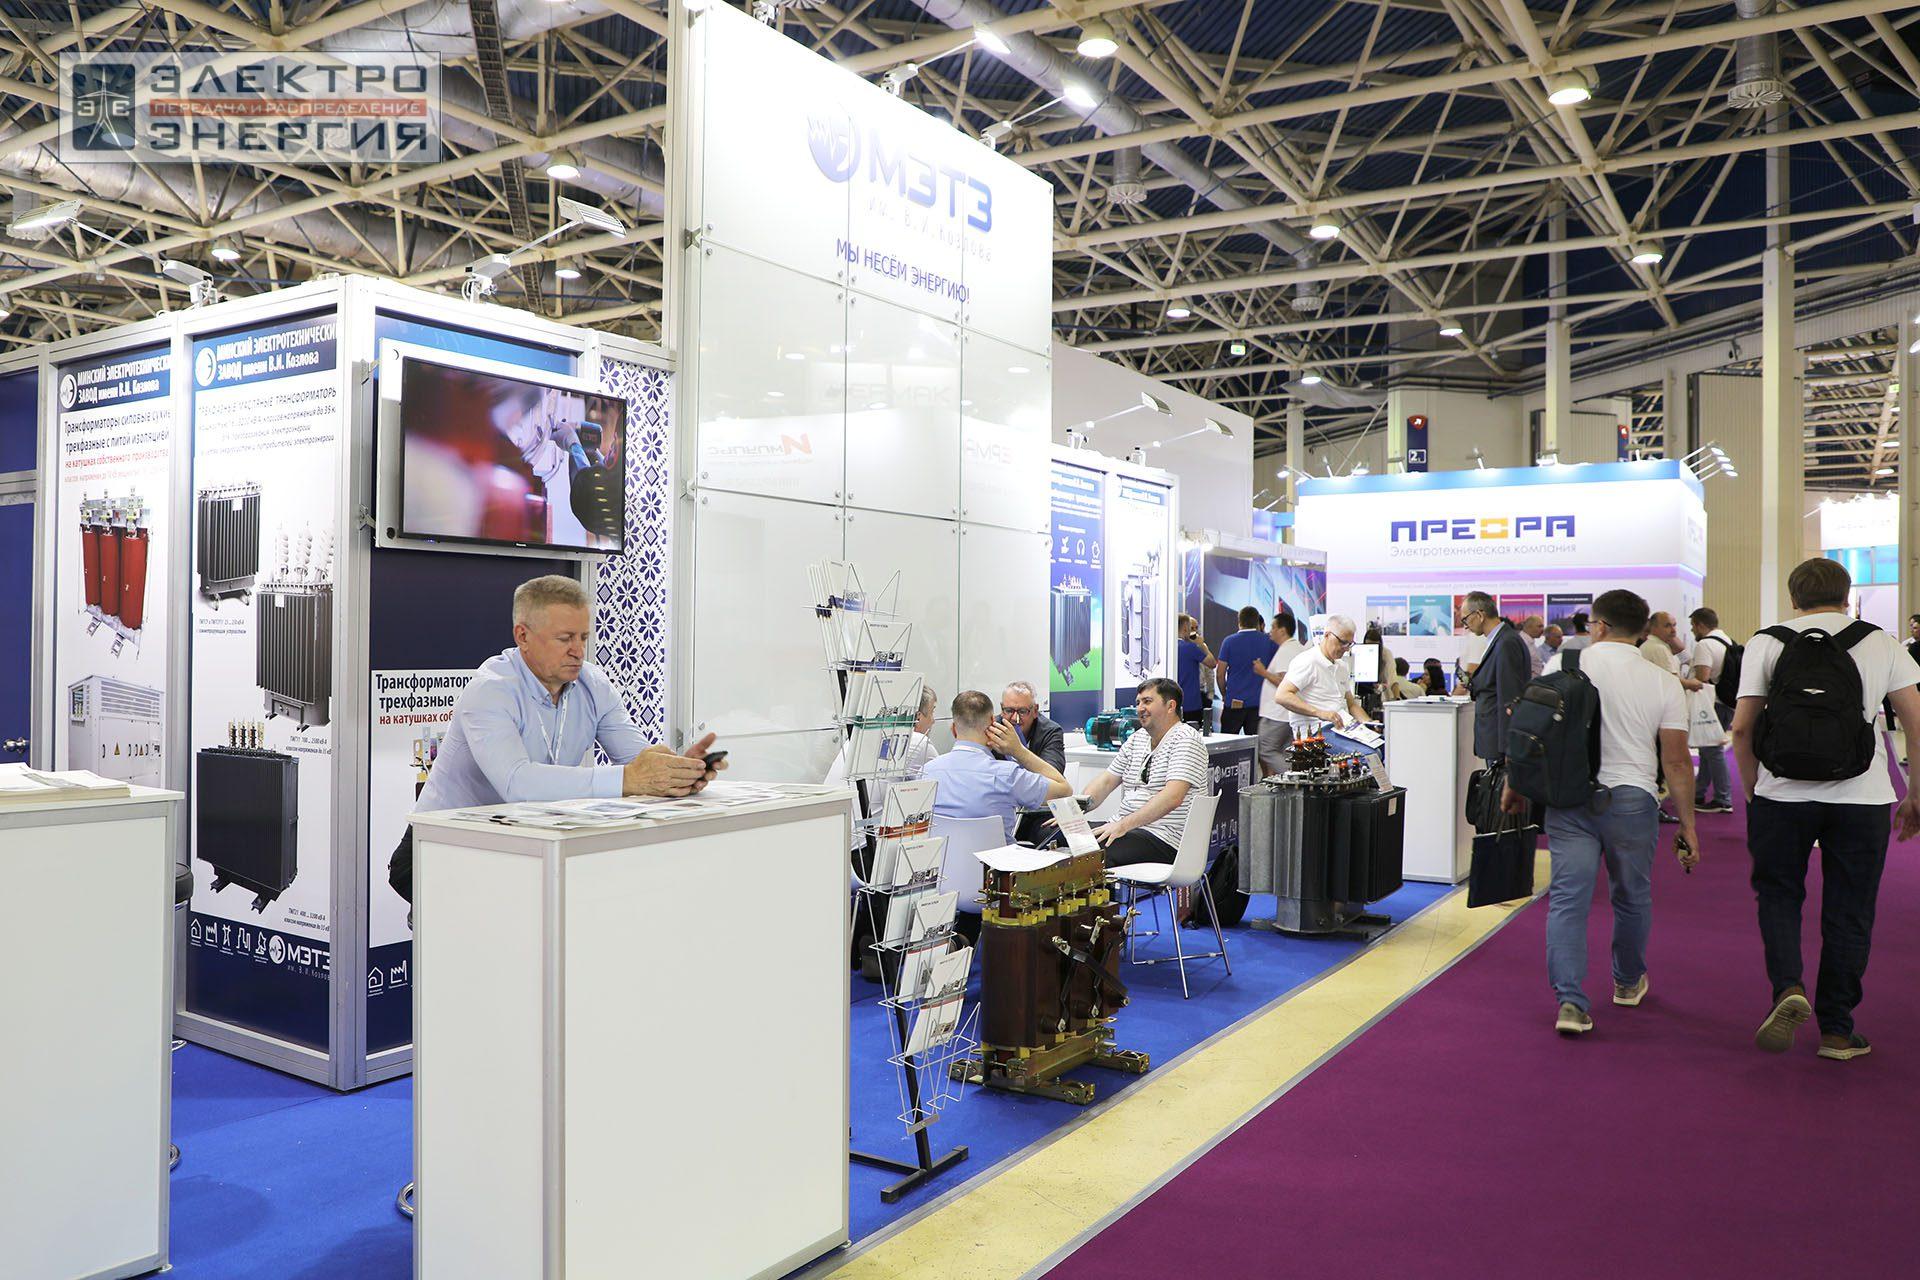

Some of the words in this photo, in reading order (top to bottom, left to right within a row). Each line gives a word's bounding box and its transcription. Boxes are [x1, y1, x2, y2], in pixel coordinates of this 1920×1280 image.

[868, 131, 993, 233] МЭТЗ
[837, 238, 859, 264] МЫ
[864, 248, 907, 281] НЕСЁМ
[911, 266, 970, 304] ЭНЕРГИЮ!
[217, 336, 253, 361] МИНСКИЙ
[78, 365, 106, 387] МИНСКИЙ
[217, 361, 242, 380] ЗАВОД
[243, 361, 268, 376] имени
[268, 354, 285, 372] В.И.
[286, 351, 319, 369] Козлова
[79, 386, 98, 404] ЗАВОД
[98, 386, 119, 400] имени
[133, 379, 160, 395] Козлова
[64, 415, 120, 437] Трансформаторы
[121, 411, 150, 426] силовые
[66, 437, 105, 456] трехфазные
[110, 432, 130, 447] литой
[131, 427, 169, 445] изоляцией
[65, 460, 72, 468] на
[72, 457, 96, 470] катушках
[1391, 515, 1575, 542] ПРЕОРА
[1390, 544, 1511, 558] Электротехническая
[1514, 543, 1577, 555] компания
[376, 673, 473, 693] Трансформатор
[379, 692, 454, 713] трехфазные
[380, 715, 391, 725] на
[393, 713, 438, 726] катушках
